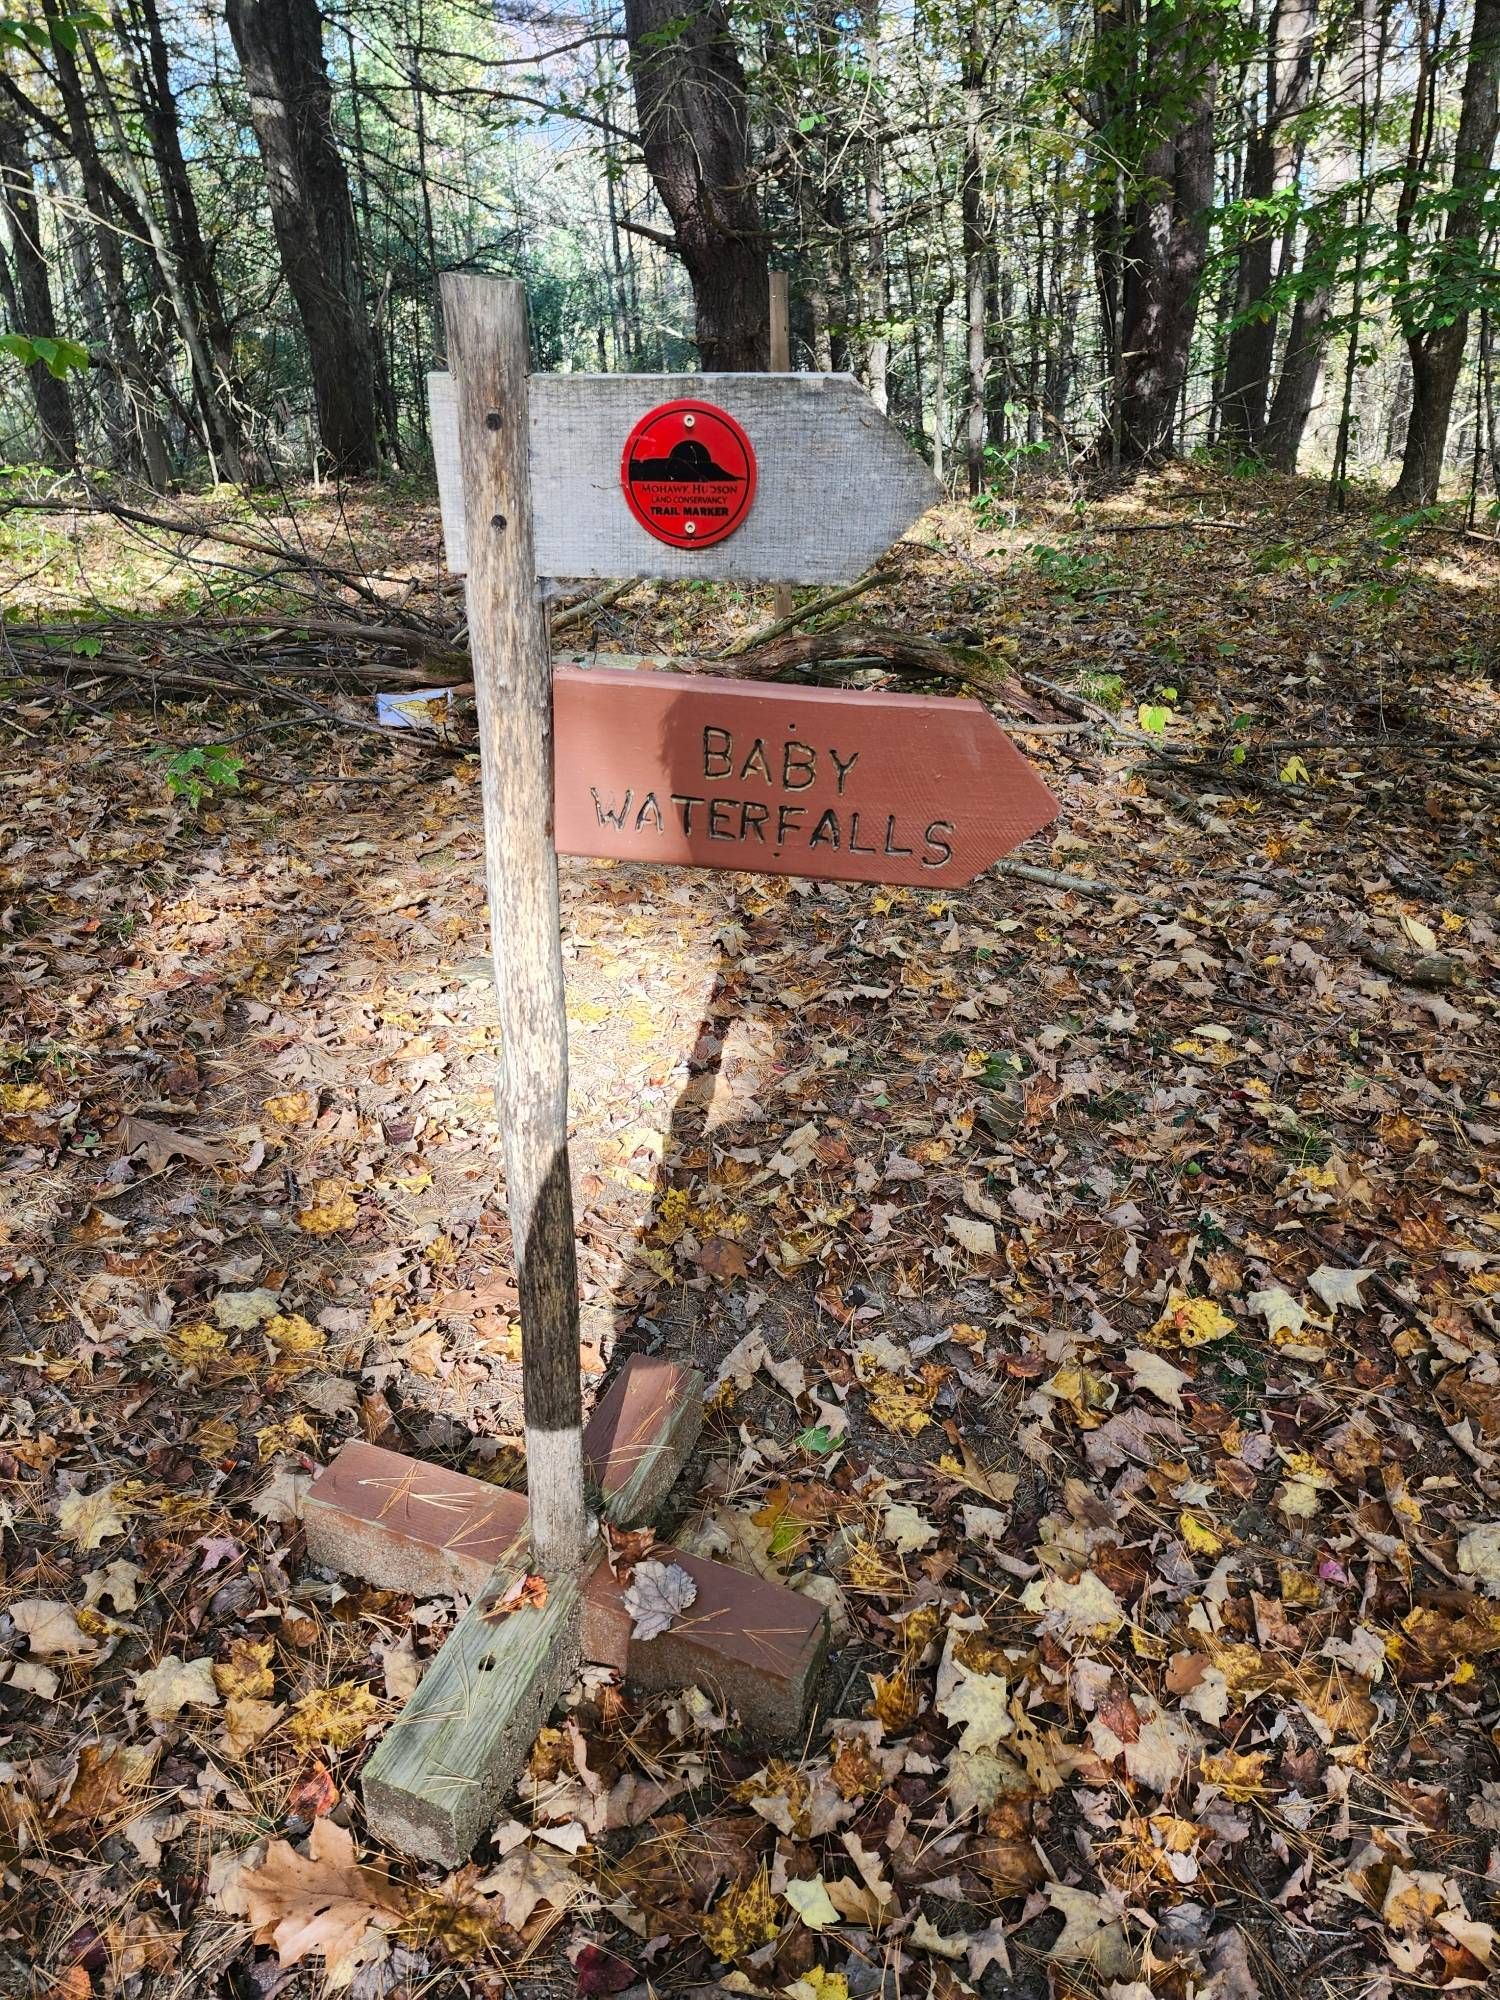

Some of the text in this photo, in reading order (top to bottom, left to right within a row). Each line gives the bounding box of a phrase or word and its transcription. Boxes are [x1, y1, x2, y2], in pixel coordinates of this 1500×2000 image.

[650, 506, 729, 517] TRAIL MARKER
[652, 496, 728, 504] LAND CONSERVANCY
[702, 724, 860, 797] BABY
[588, 785, 957, 871] WATERFALLS
